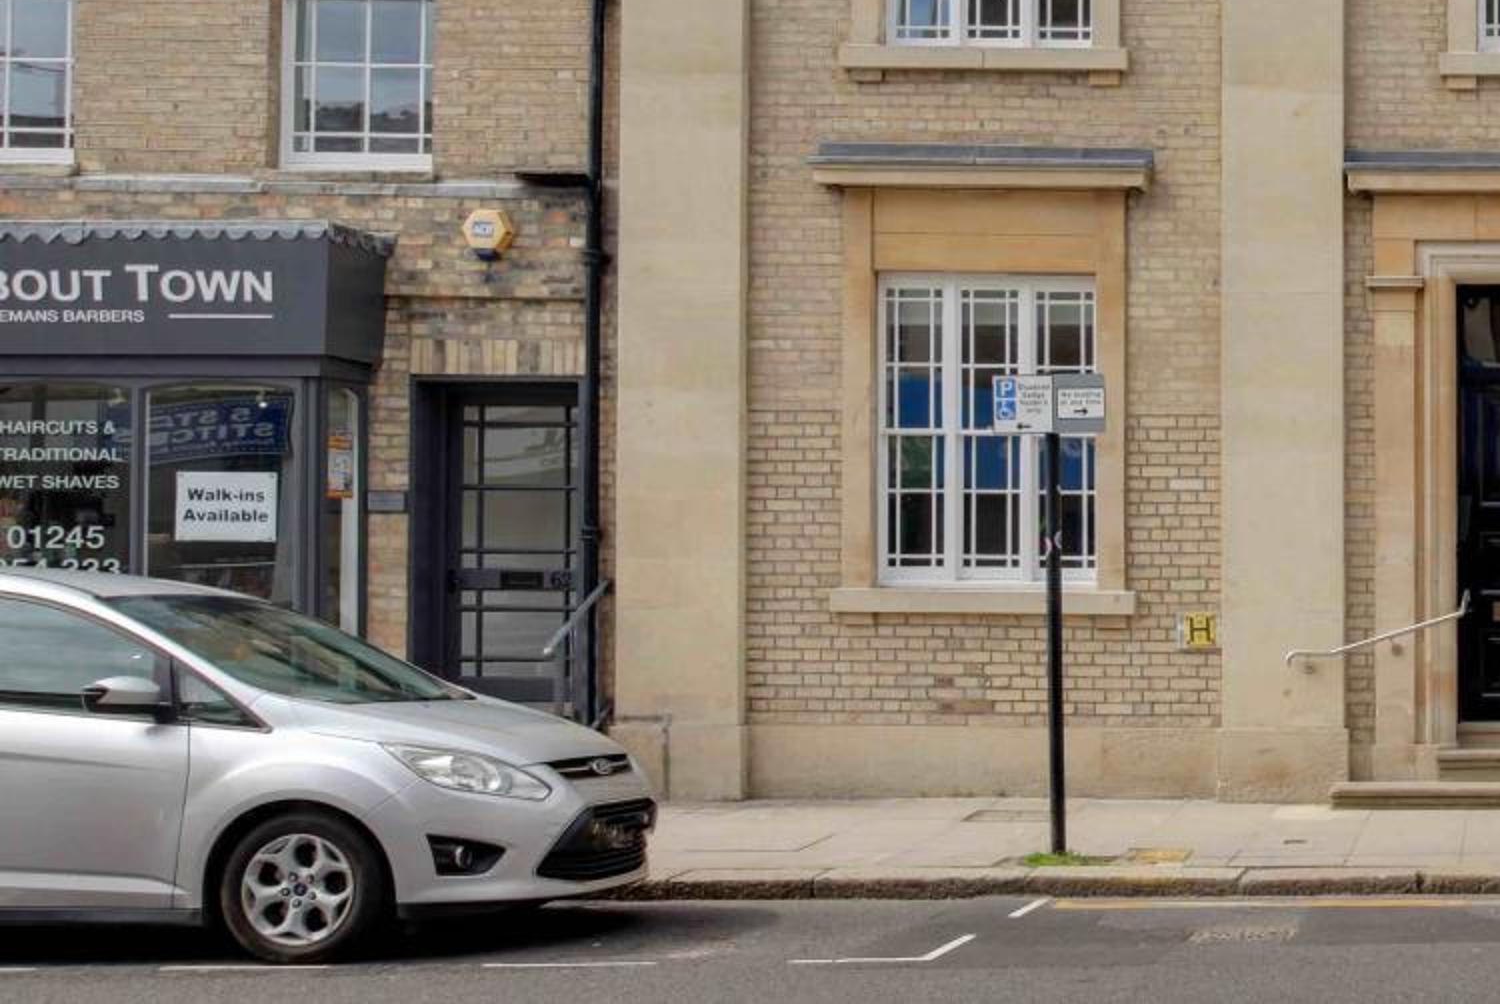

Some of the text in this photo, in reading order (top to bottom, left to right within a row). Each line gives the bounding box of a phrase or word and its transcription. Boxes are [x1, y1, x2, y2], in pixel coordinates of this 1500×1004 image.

[124, 263, 274, 303] TOWN
[63, 309, 146, 324] BARBERS
[1001, 380, 1014, 396] P
[0, 420, 116, 434] HAIRCUTS &
[0, 475, 121, 489] WET SHAVES
[187, 487, 266, 503] Walk-ins
[183, 508, 269, 523] Available
[7, 525, 105, 549] 01245
[1189, 616, 1211, 643] H
